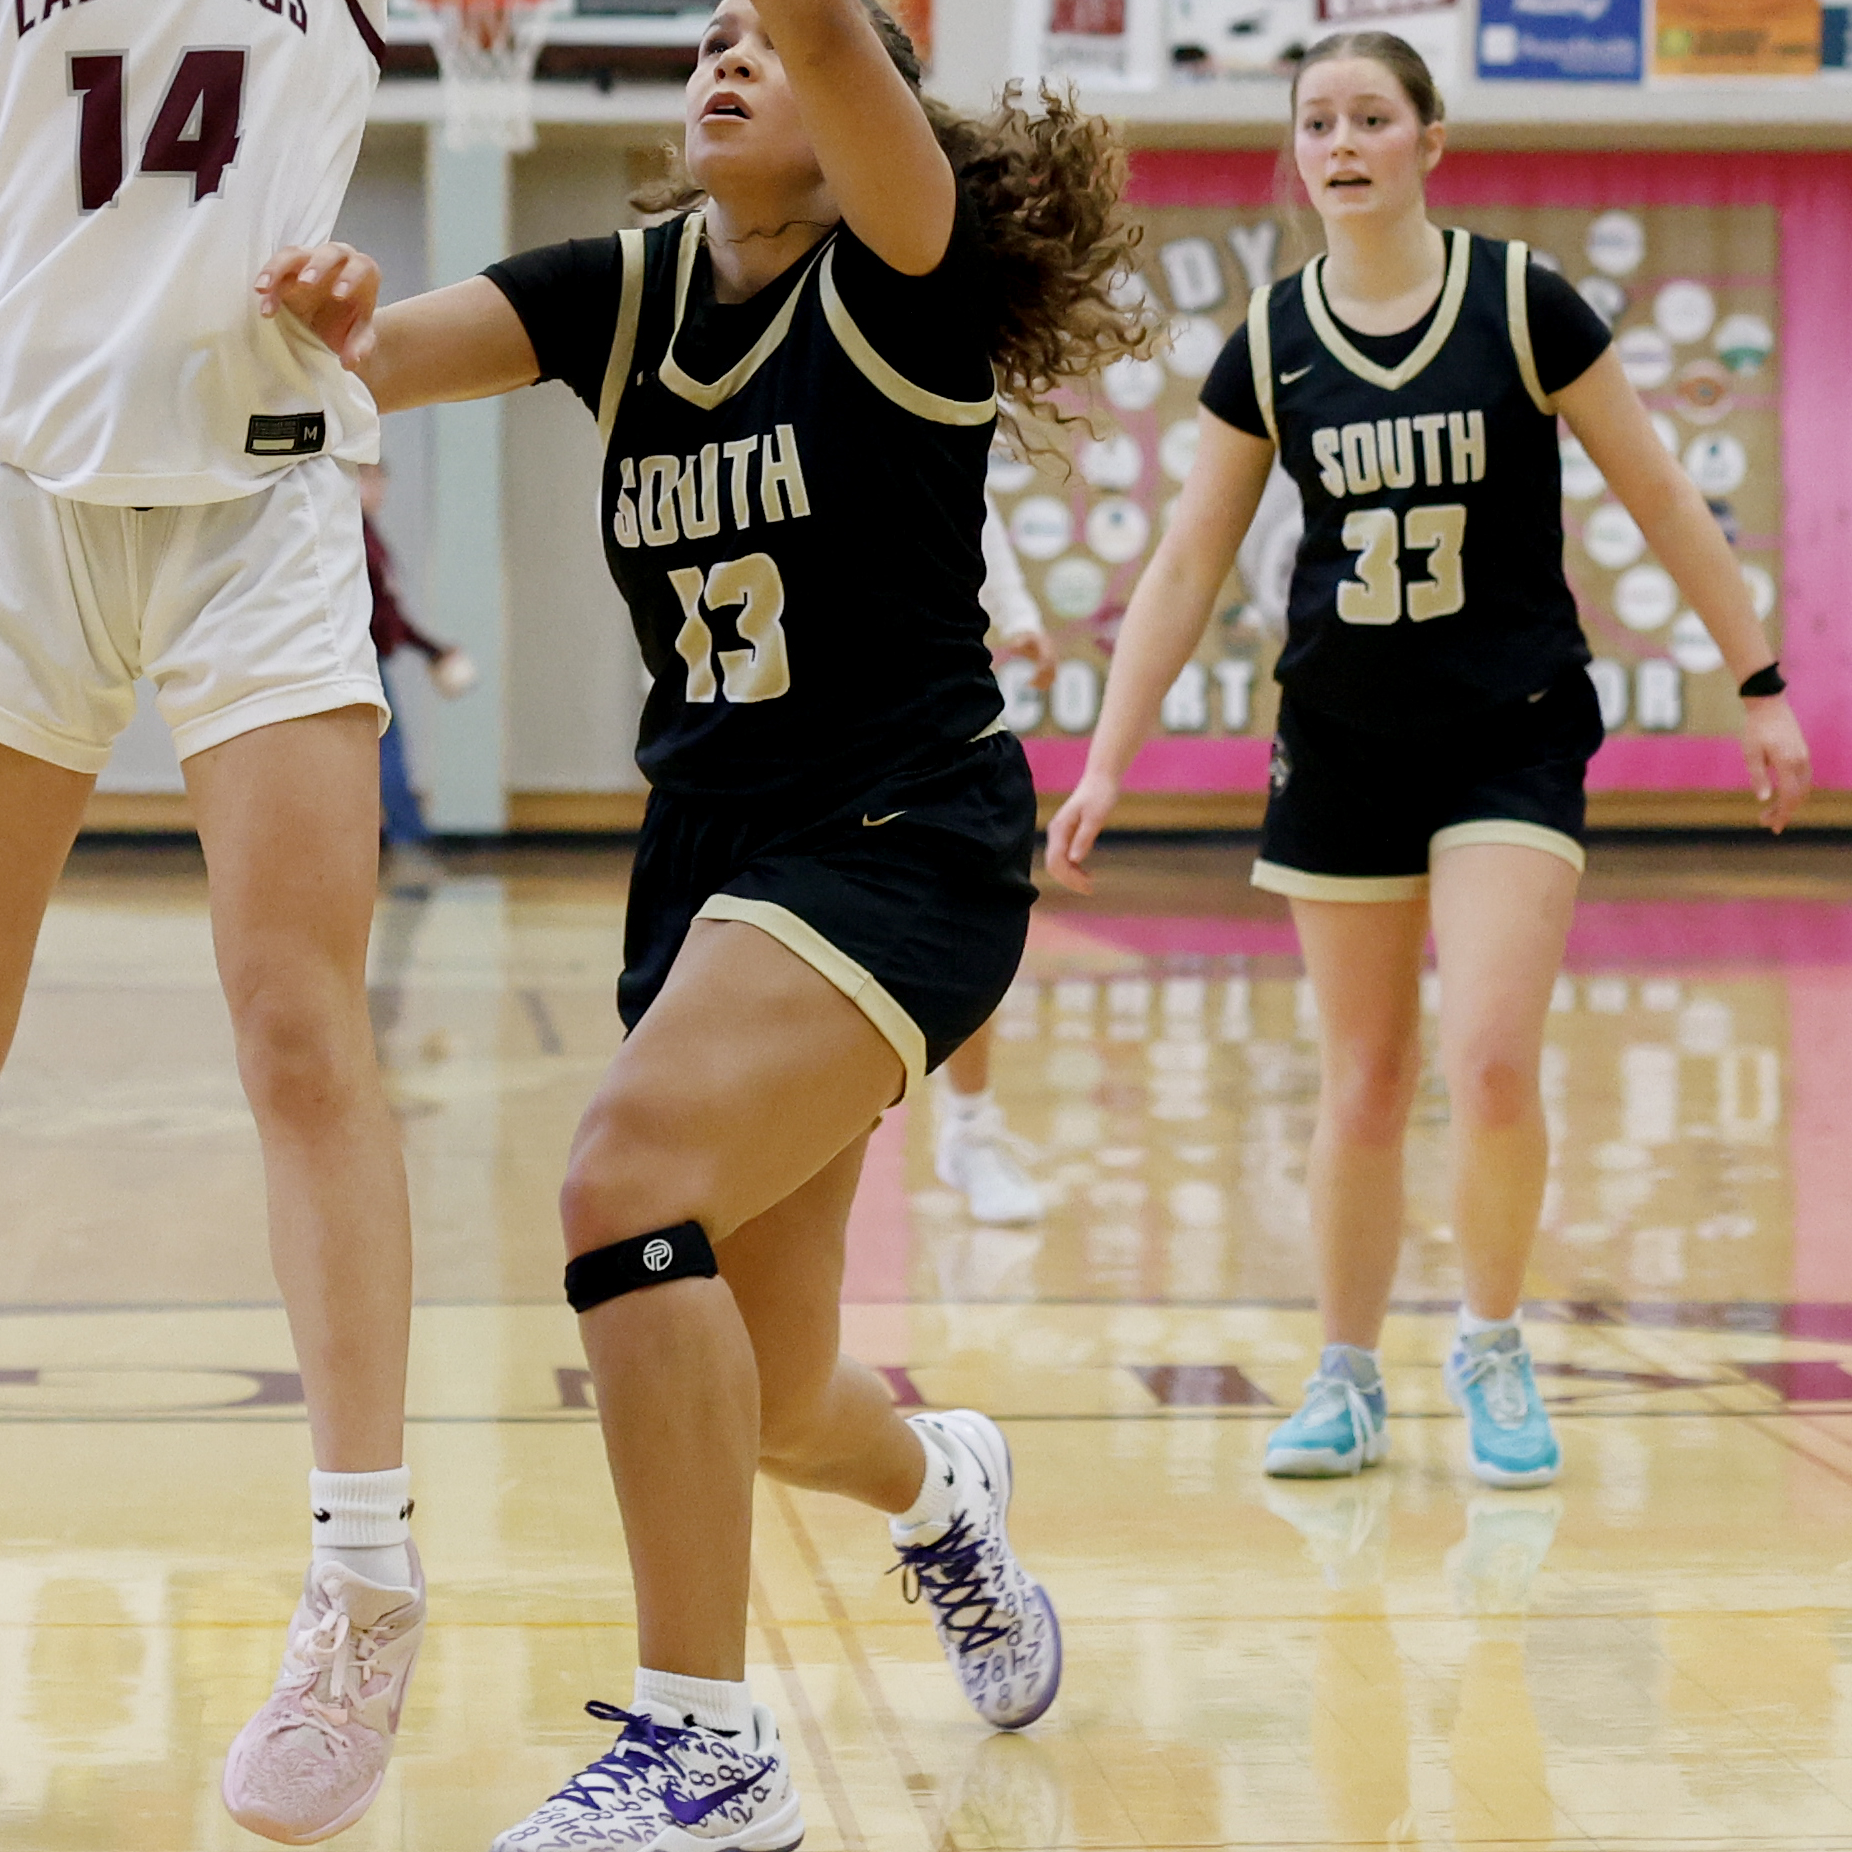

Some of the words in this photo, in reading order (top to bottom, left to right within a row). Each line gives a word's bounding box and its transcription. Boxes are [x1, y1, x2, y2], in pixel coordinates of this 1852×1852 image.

[65, 44, 252, 217] 14
[303, 425, 318, 442] M
[613, 422, 812, 548] SOUTH
[1311, 409, 1487, 499] SOUTH
[1336, 503, 1468, 626] 33
[666, 552, 792, 704] 13
